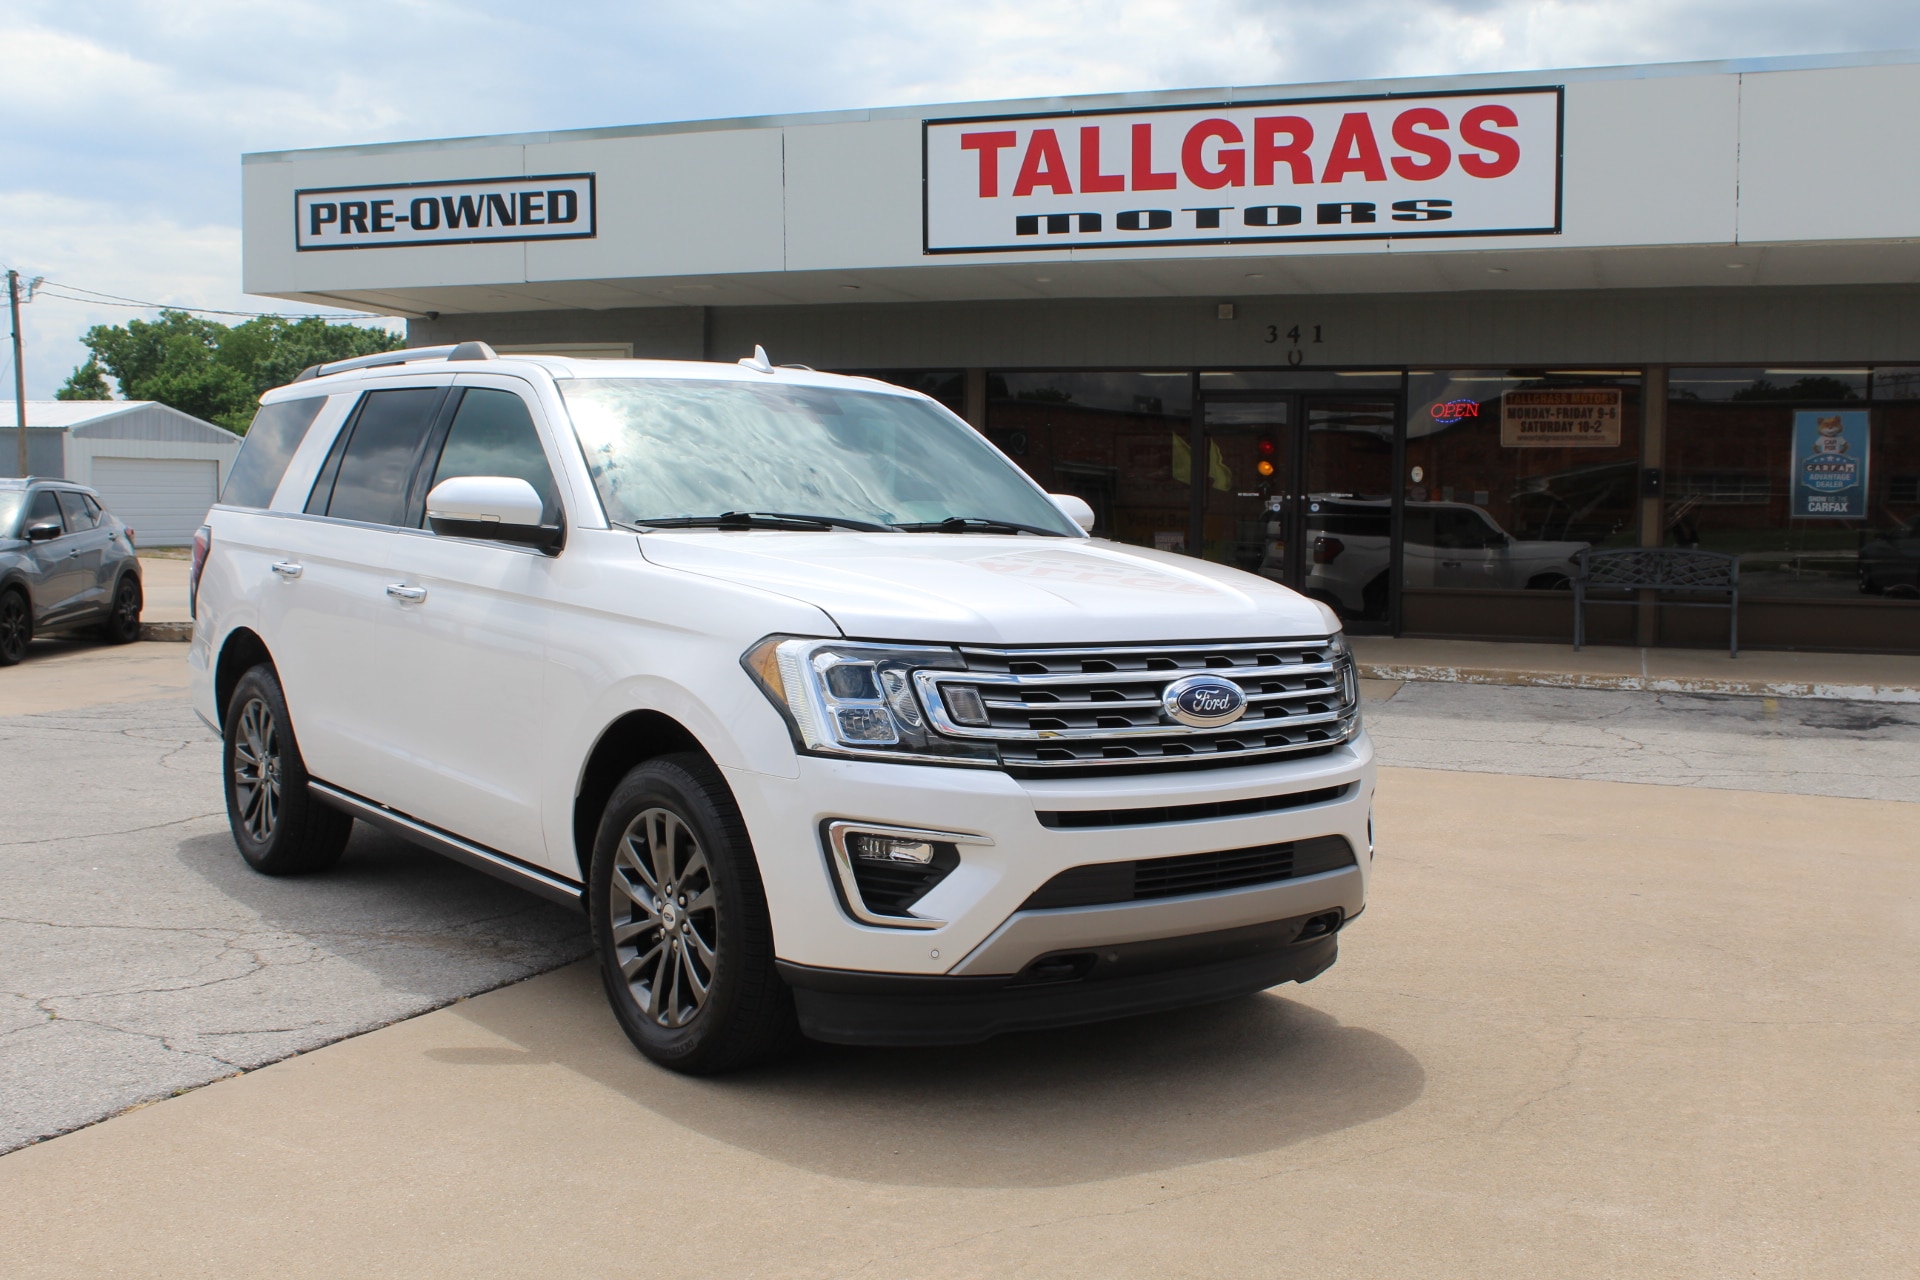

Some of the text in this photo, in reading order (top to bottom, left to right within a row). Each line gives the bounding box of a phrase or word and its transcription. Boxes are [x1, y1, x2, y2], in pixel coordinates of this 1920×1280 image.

[960, 104, 1521, 198] TALLGRASS
[309, 189, 578, 236] PRE-OWNED
[1015, 199, 1452, 236] MOTORS
[1264, 325, 1324, 344] 341
[1508, 393, 1616, 404] TALLGRASS MOTORS
[1430, 403, 1480, 418] OPEN
[1507, 407, 1594, 420] MONDAY-FRIDAY
[1520, 420, 1602, 433] SATURDAY 10-2
[1807, 464, 1854, 472] CARFAX
[1808, 502, 1848, 512] CARFAX
[1192, 689, 1230, 712] Ford
